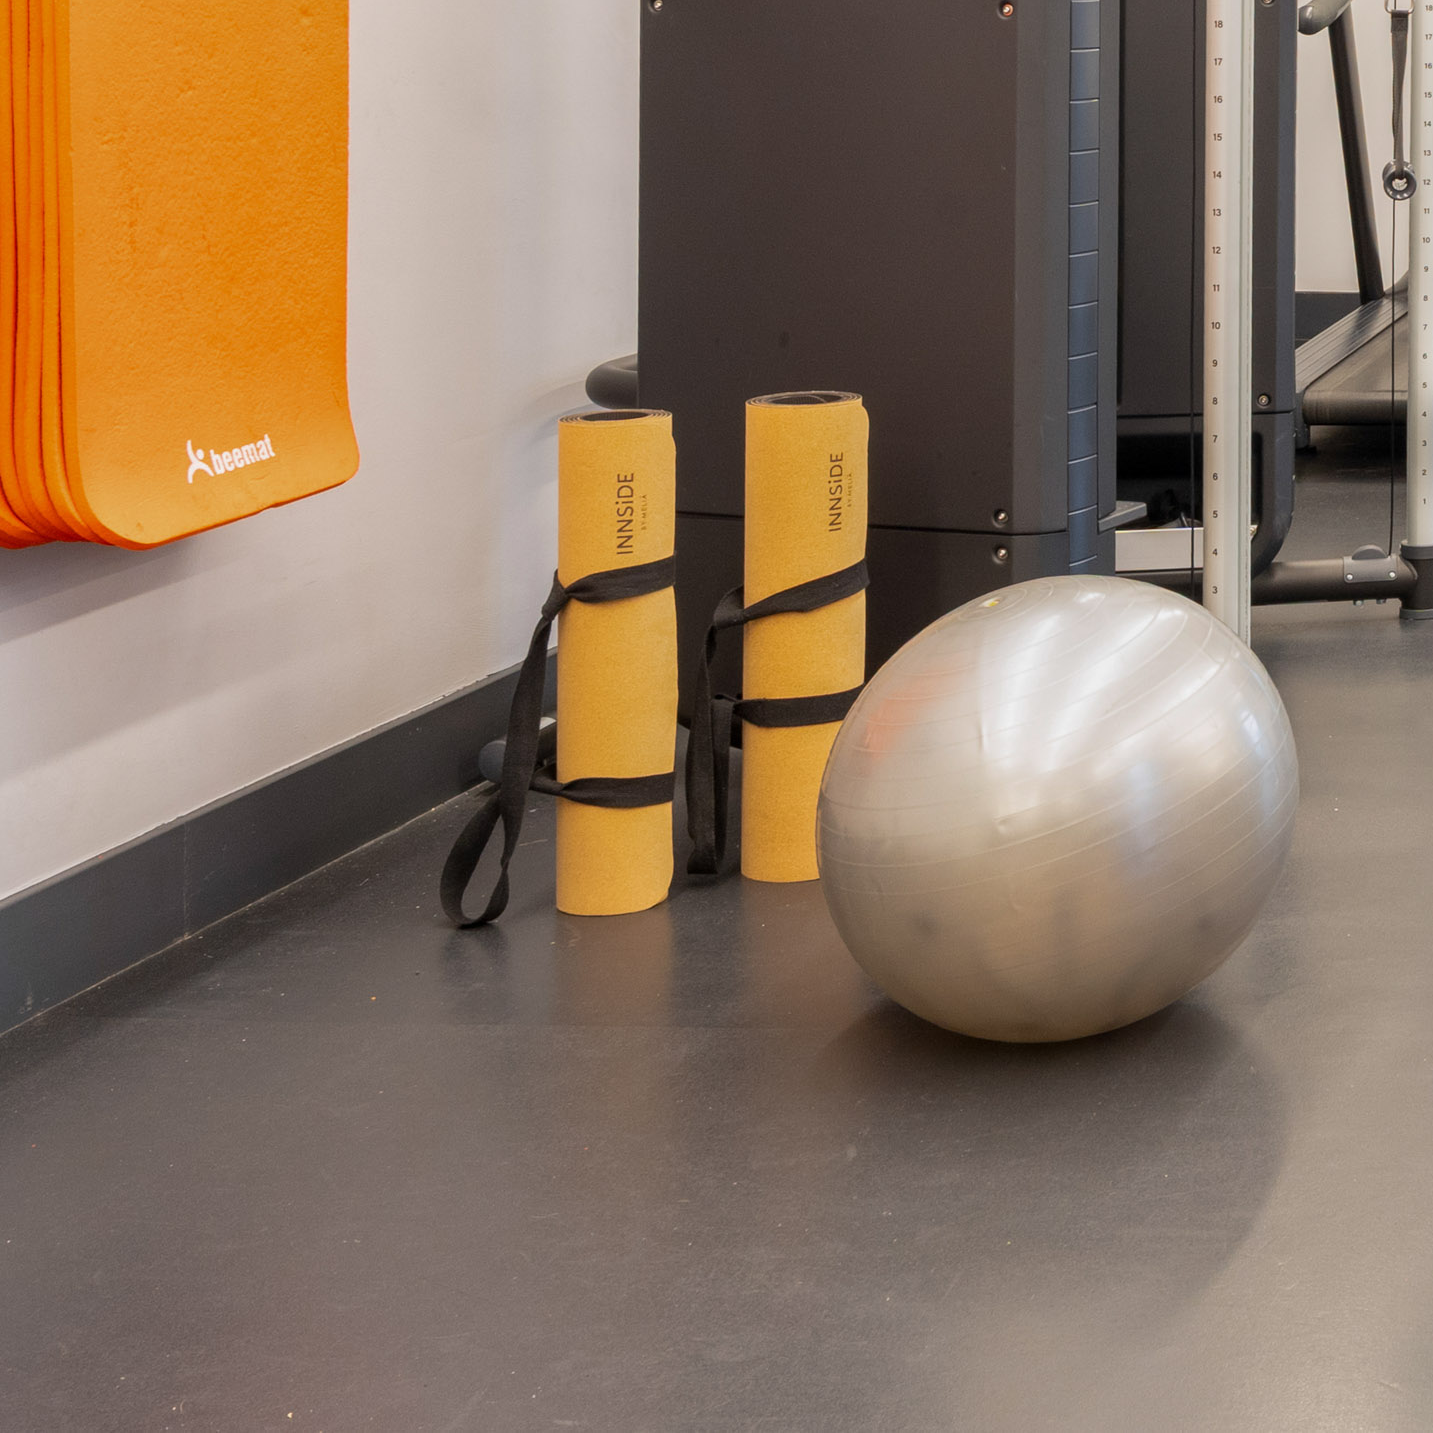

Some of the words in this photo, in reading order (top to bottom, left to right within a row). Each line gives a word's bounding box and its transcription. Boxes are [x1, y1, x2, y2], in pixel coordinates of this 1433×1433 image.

[1425, 4, 1433, 12] 18
[1214, 19, 1224, 29] 18
[1424, 33, 1433, 41] 17
[1213, 57, 1223, 66] 17
[1424, 62, 1433, 70] 16
[1424, 91, 1433, 99] 15
[1213, 95, 1224, 104] 16
[1213, 132, 1223, 142] 15
[1423, 149, 1432, 157] 13
[1212, 170, 1222, 179] 14
[1422, 178, 1431, 186] 12
[1212, 208, 1222, 217] 13
[1423, 207, 1430, 215] 11
[1422, 236, 1431, 244] 10
[1212, 246, 1222, 255] 12
[1423, 265, 1429, 273] 9
[1212, 283, 1221, 292] 11
[1422, 294, 1429, 302] 8
[1211, 321, 1221, 330] 10
[1422, 323, 1428, 331] 7
[1422, 352, 1428, 360] 6
[1212, 359, 1218, 368] 9
[1422, 381, 1428, 389] 5
[1212, 396, 1219, 406] 8
[1212, 434, 1218, 443] 7
[1421, 439, 1428, 447] 3
[210, 433, 276, 476] beemat
[1421, 468, 1427, 476] 2
[1212, 472, 1219, 481] 6
[1422, 497, 1427, 505] 1
[1212, 509, 1219, 519] 5
[1212, 548, 1218, 556] 4
[1212, 585, 1218, 595] 3
